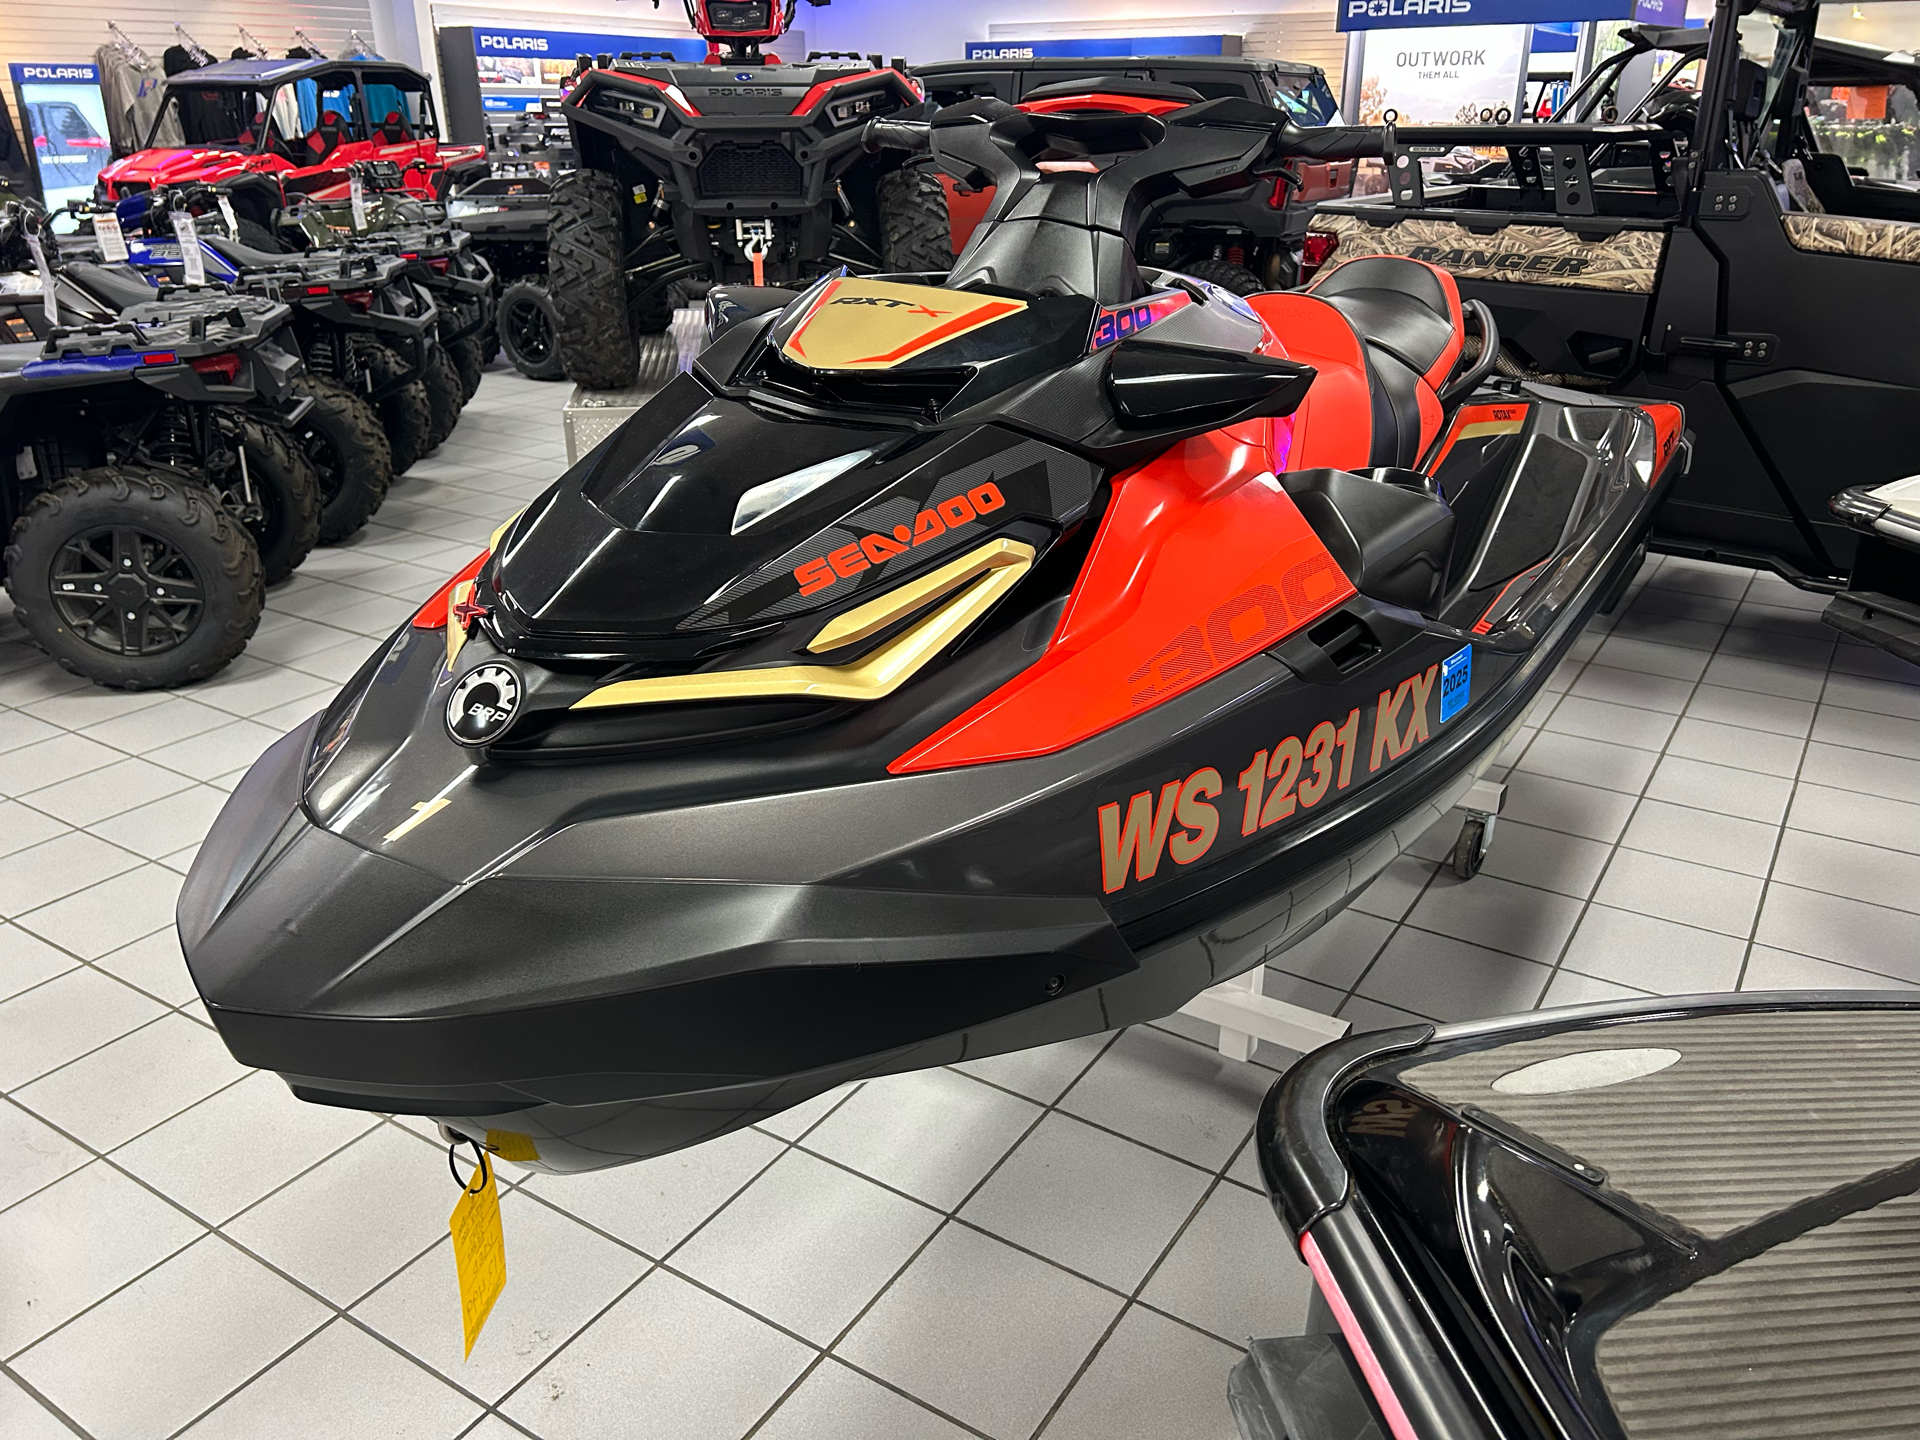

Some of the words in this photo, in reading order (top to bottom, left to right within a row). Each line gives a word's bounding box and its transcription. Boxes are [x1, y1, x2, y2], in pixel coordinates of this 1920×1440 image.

[1348, 0, 1471, 17] POLARIS
[480, 35, 548, 51] POLARIS
[971, 48, 1033, 59] POLARIS
[1396, 49, 1486, 68] OUTWORK
[23, 67, 94, 78] POLARIS
[1418, 71, 1441, 80] THEM
[1442, 70, 1460, 79] ALL
[708, 88, 783, 97] POLARIS
[1408, 246, 1590, 276] RANGER
[829, 297, 915, 307] RXT
[907, 305, 952, 317] X
[1095, 305, 1151, 347] 300
[1493, 410, 1511, 420] ROTAX
[1127, 550, 1357, 706] 300
[1443, 664, 1468, 698] 2025
[468, 703, 508, 723] BRP
[1098, 767, 1223, 894] WS
[1238, 708, 1360, 837] 1231
[1369, 664, 1439, 772] KX
